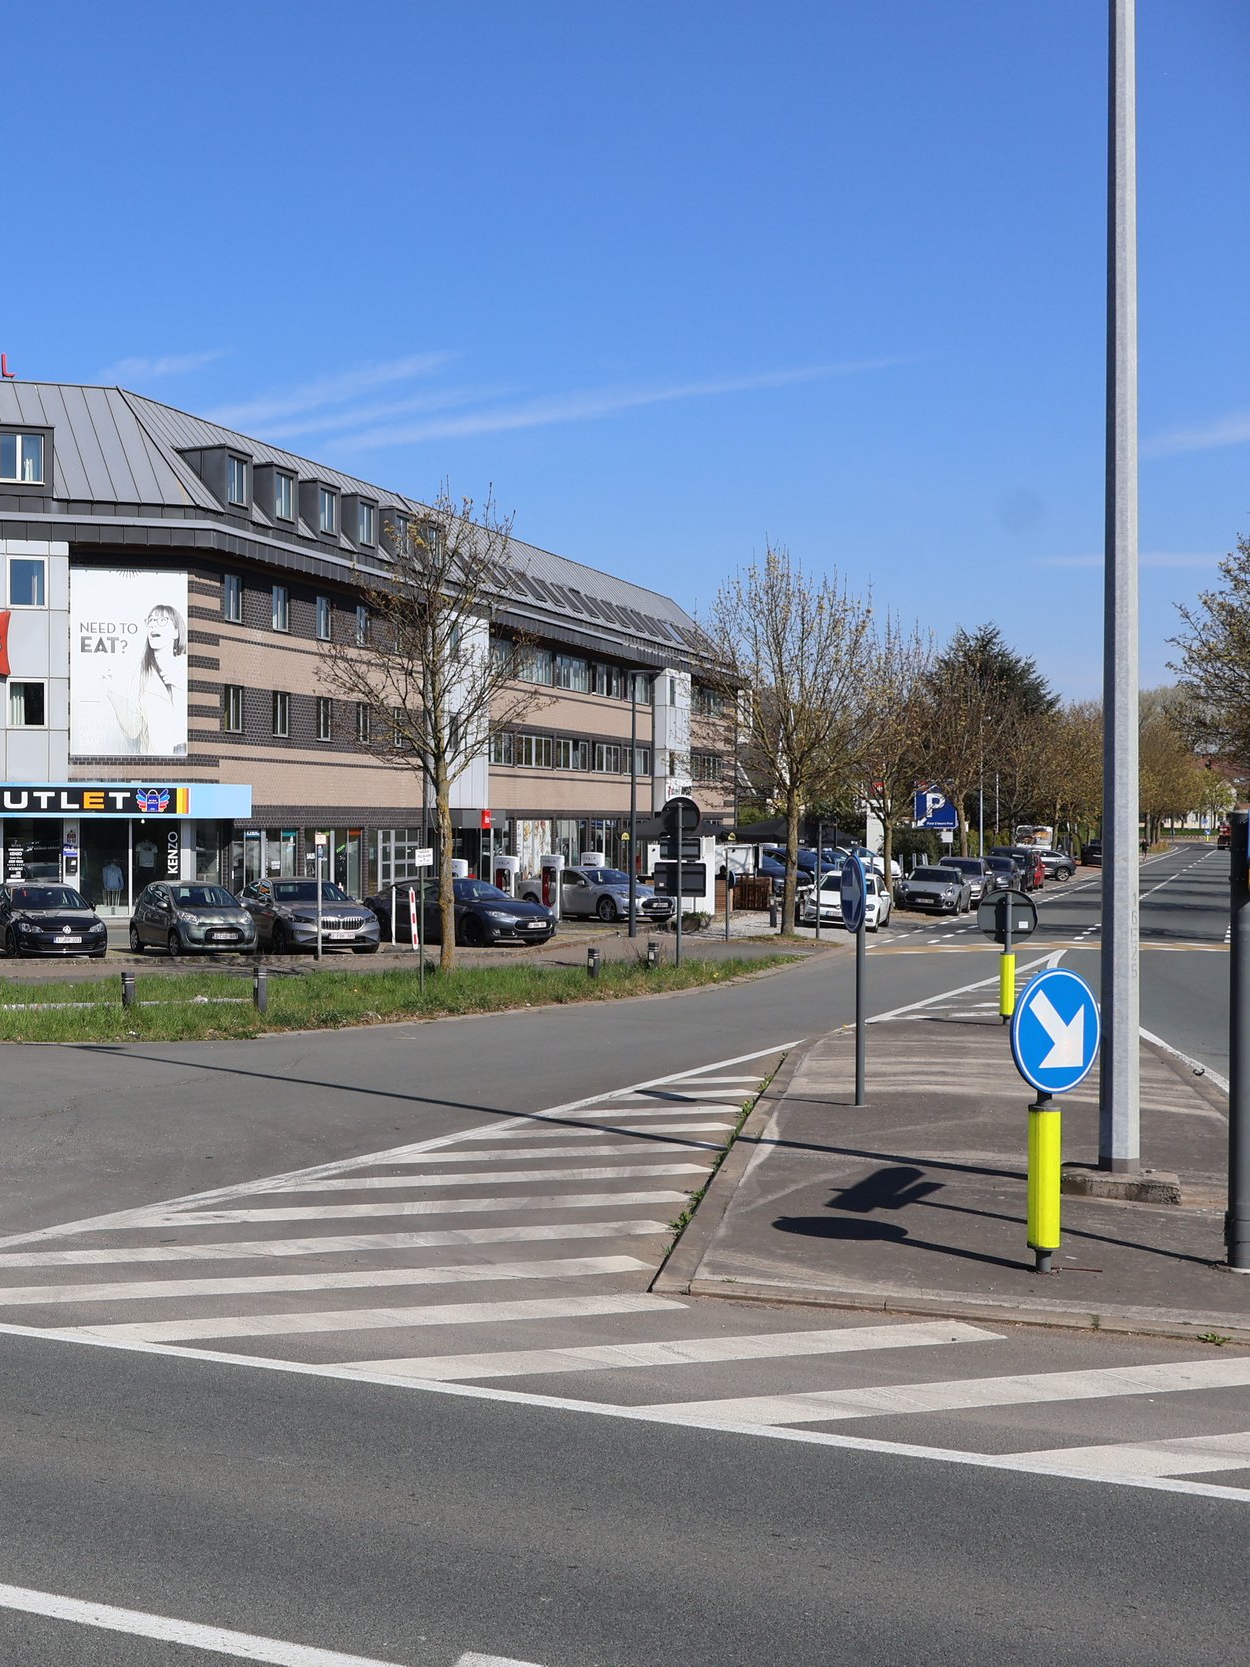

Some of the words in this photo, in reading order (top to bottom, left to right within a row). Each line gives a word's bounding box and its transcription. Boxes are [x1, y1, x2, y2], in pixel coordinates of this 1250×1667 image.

[80, 622, 116, 634] NEED
[119, 623, 138, 634] TO
[80, 636, 128, 654] EAT?
[926, 793, 946, 818] P
[167, 831, 179, 874] KENZO
